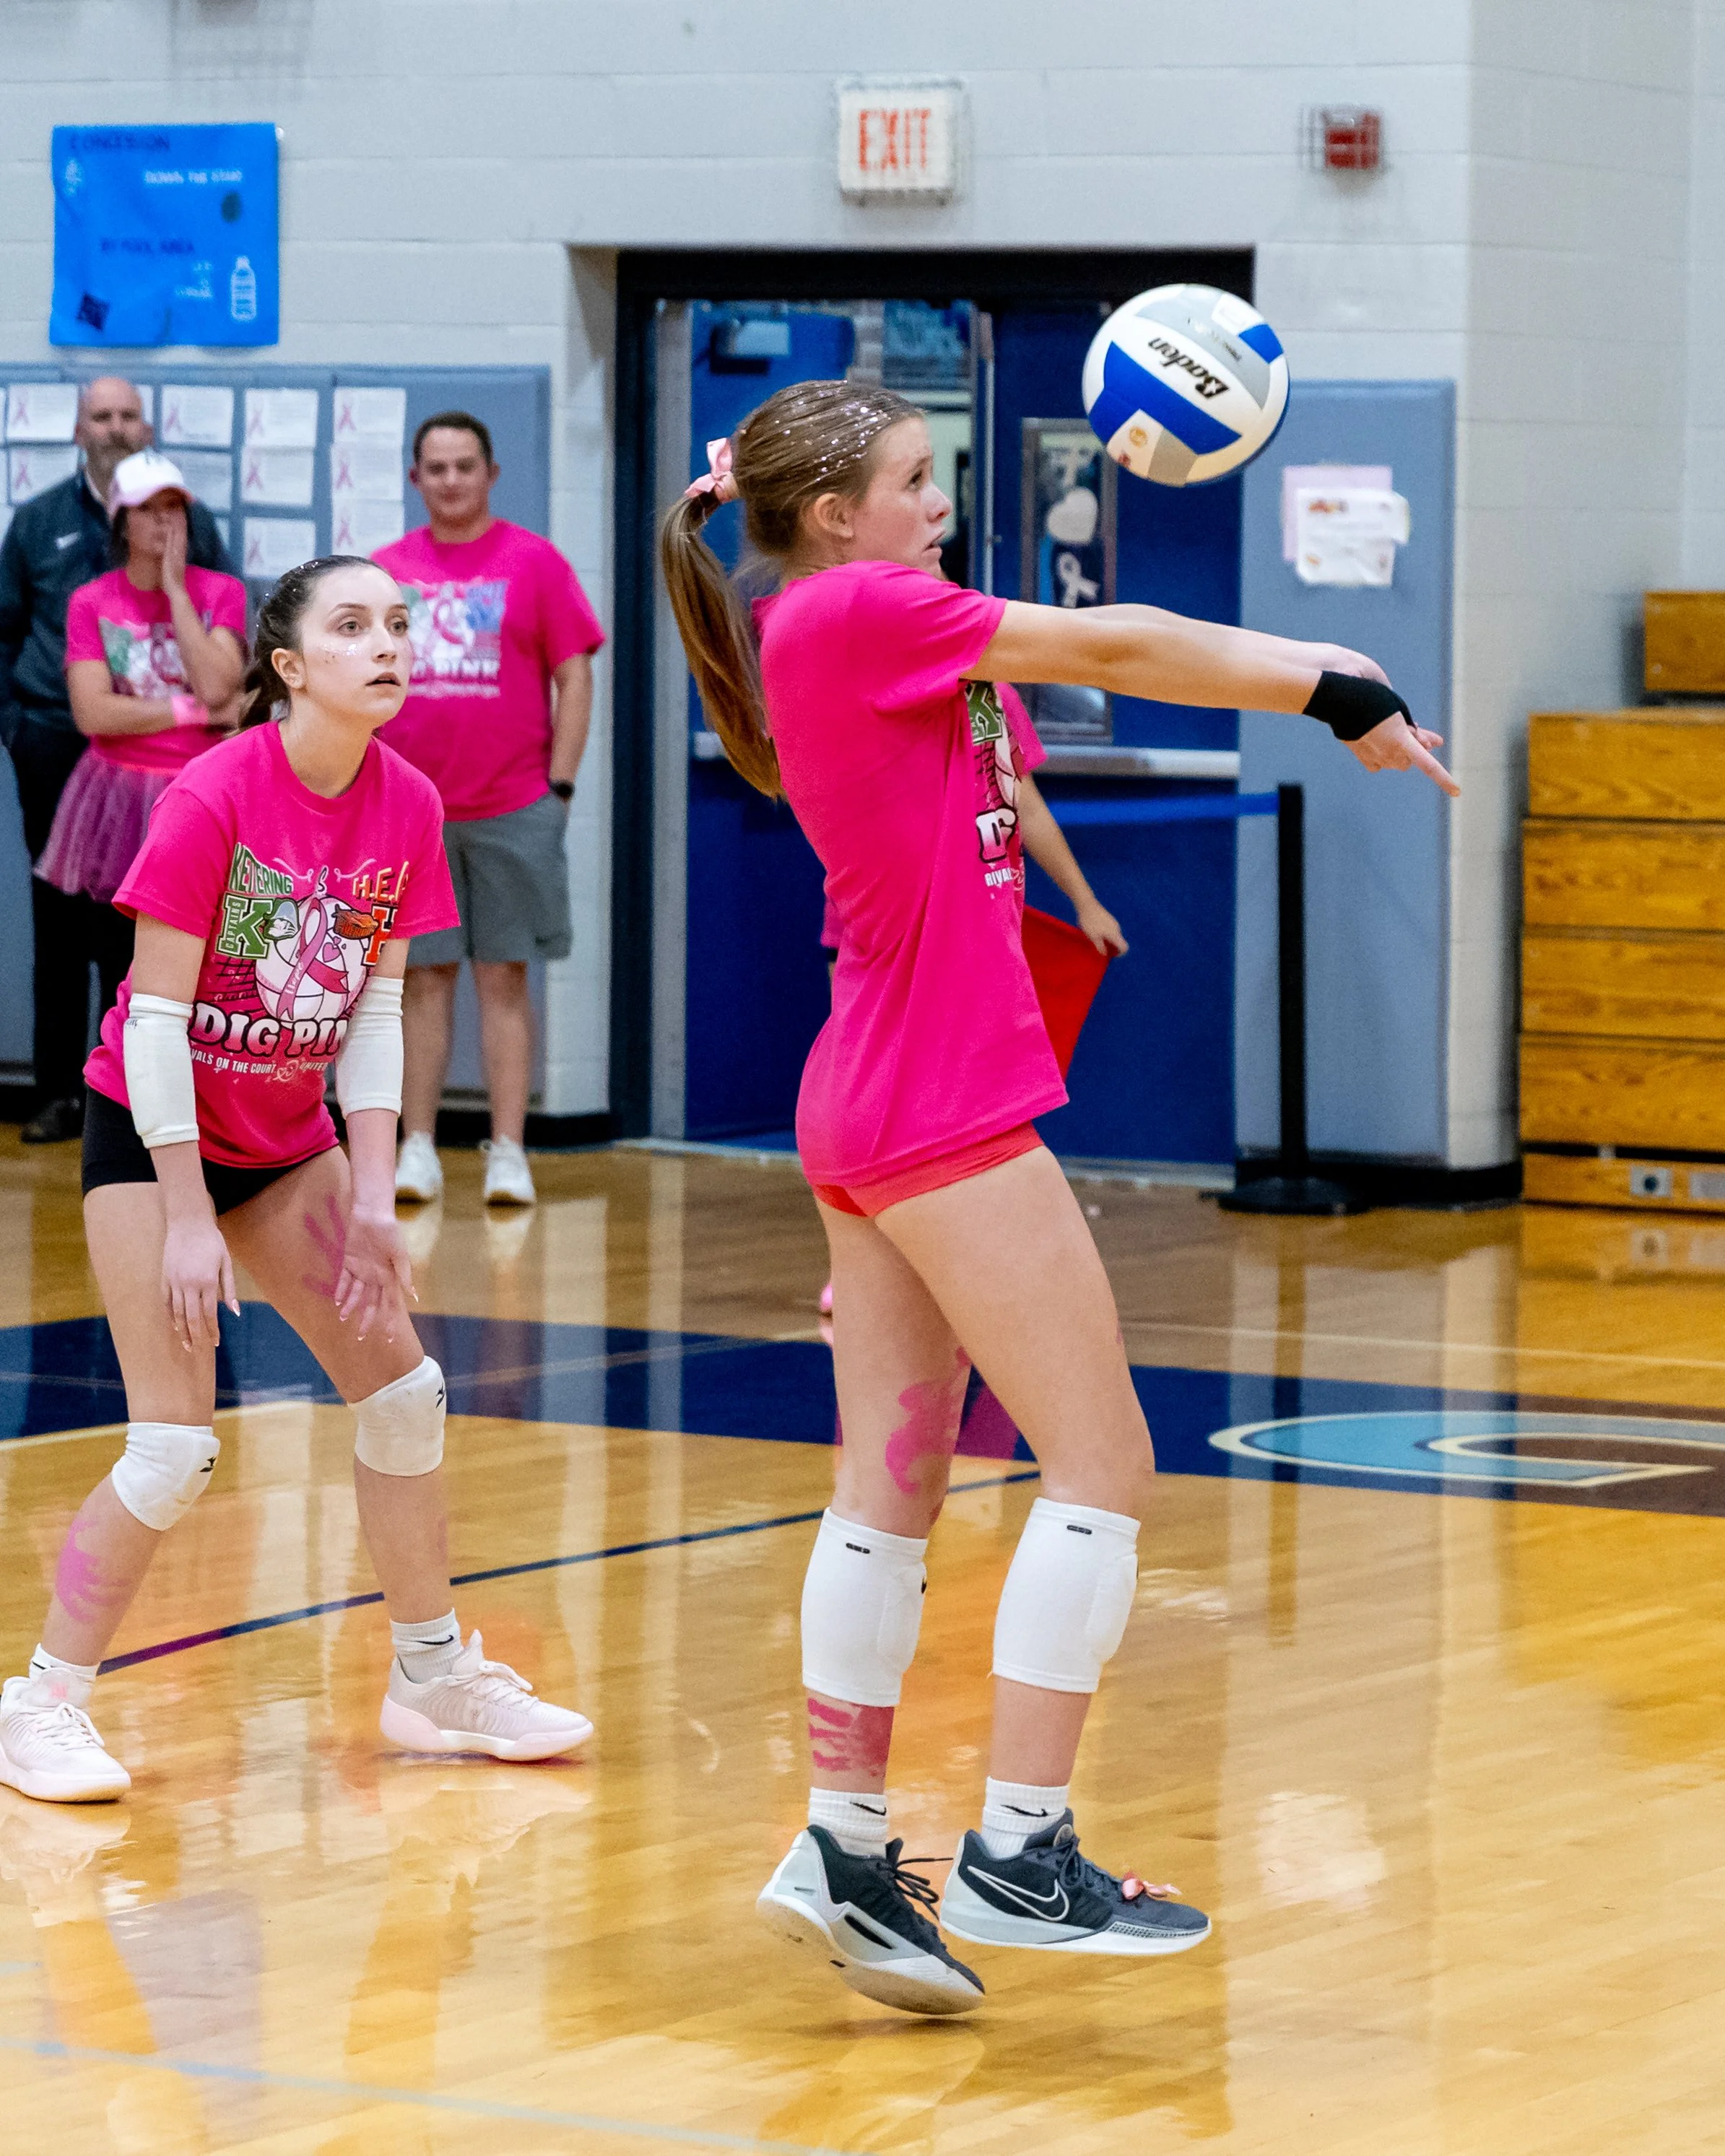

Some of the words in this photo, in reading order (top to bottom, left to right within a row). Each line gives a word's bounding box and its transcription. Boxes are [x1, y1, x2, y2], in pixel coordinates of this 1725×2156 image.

[859, 108, 931, 170] EXIT
[1148, 337, 1229, 399] Baden
[229, 842, 293, 895] KETTERING
[225, 901, 241, 949] CAPTAINS
[187, 1001, 281, 1056] DIG
[216, 1056, 229, 1069] ON
[232, 1061, 248, 1073] THE
